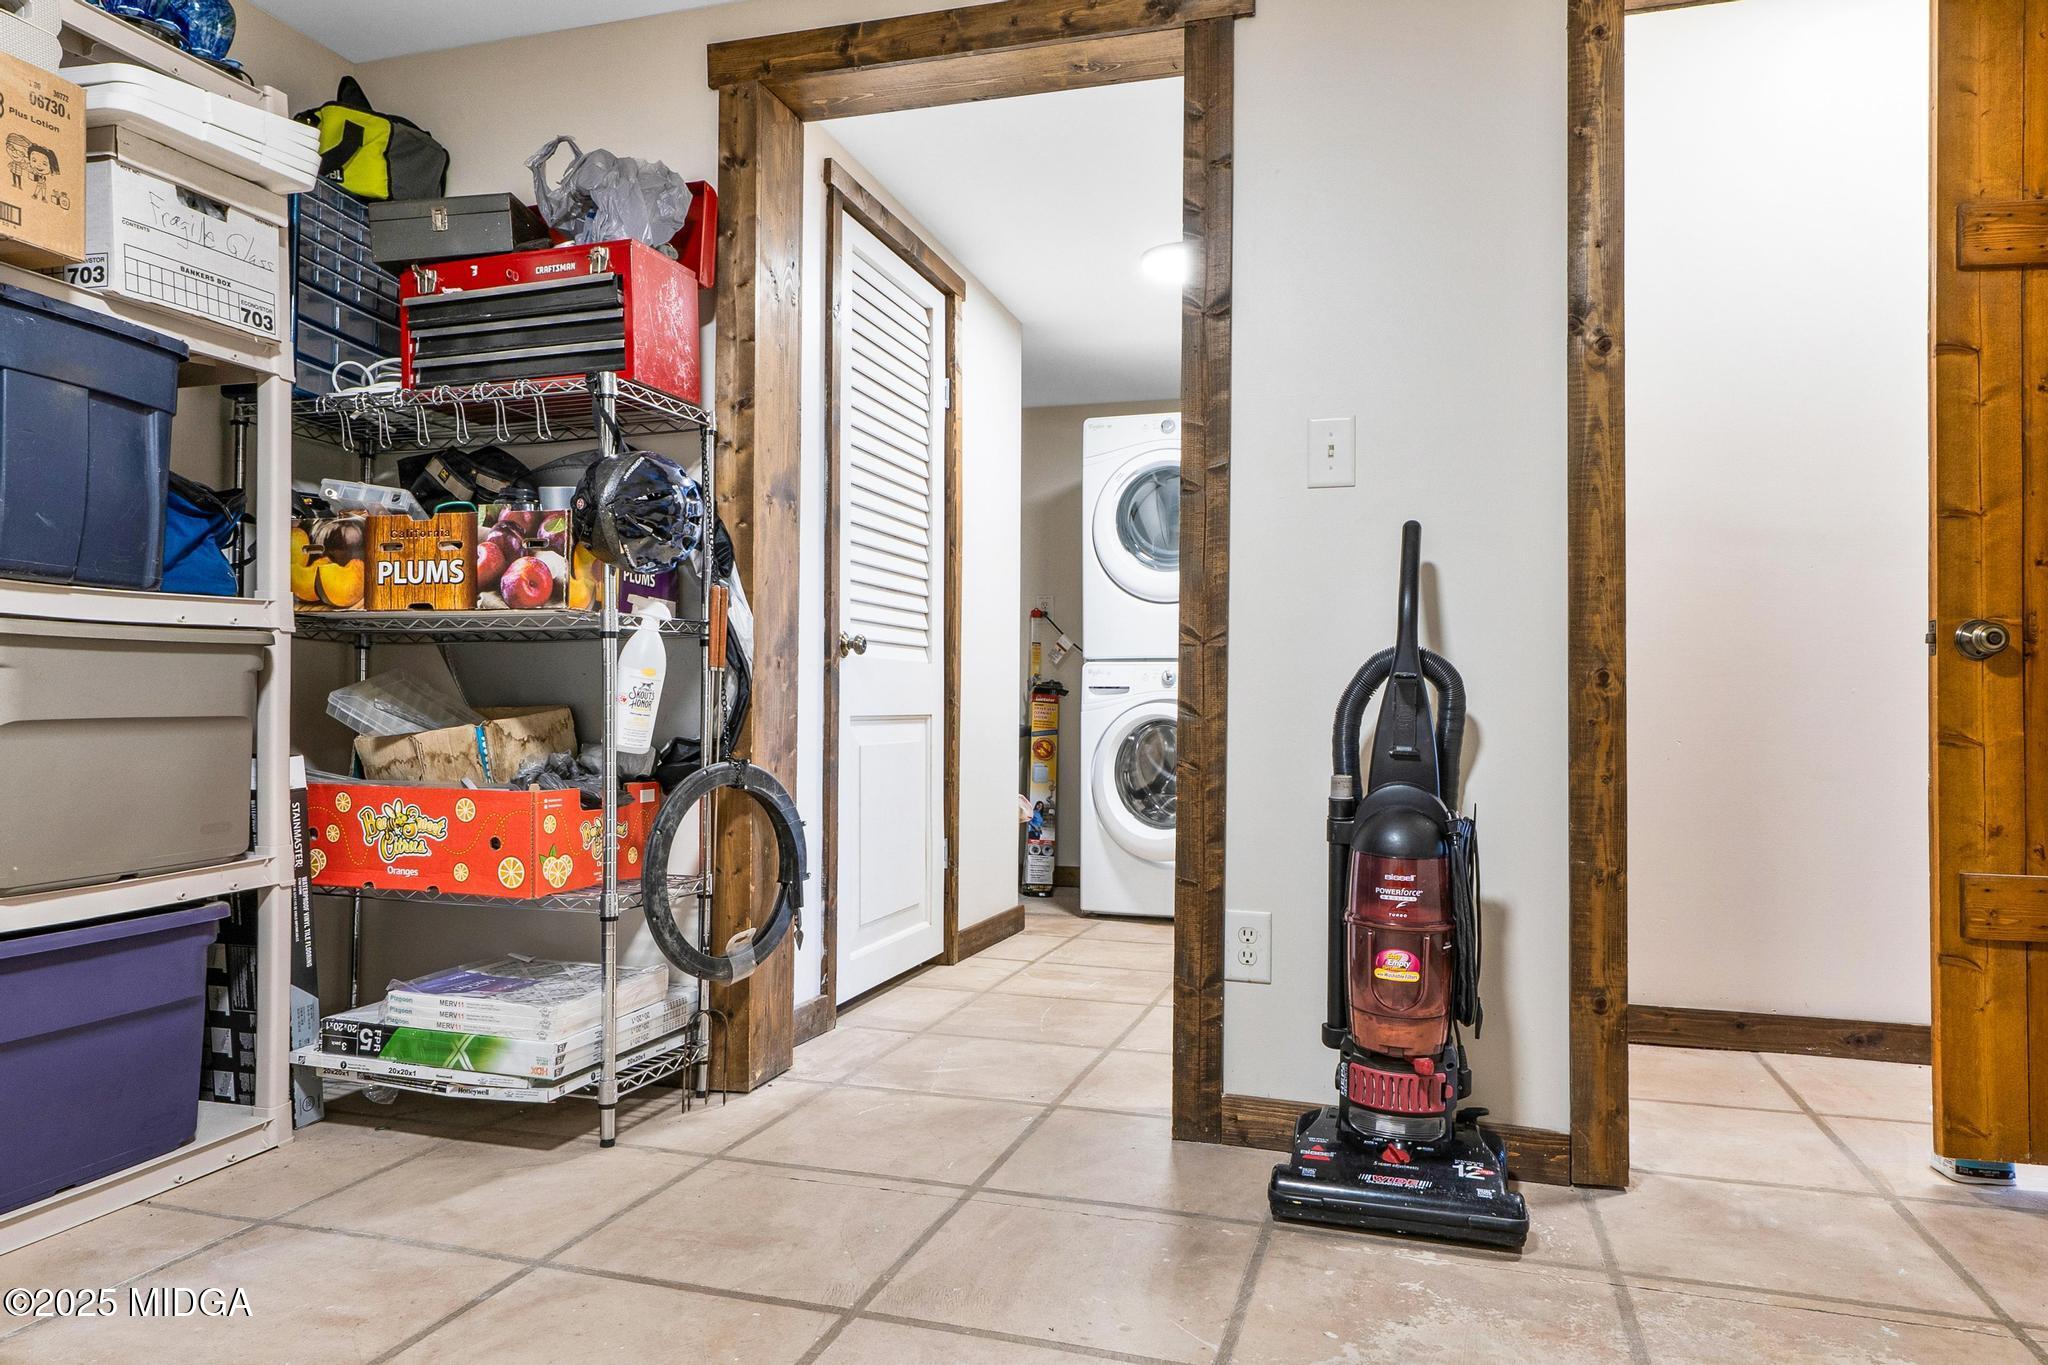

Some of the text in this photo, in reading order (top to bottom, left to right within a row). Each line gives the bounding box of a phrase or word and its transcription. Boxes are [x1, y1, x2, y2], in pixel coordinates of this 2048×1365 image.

[9, 106, 60, 133] Plus Lotion
[121, 219, 151, 232] CONTENTS
[67, 265, 105, 284] 703
[535, 262, 576, 275] CRAFTSMAN
[180, 266, 232, 288] BANKERS BOX
[241, 306, 274, 331] 703
[390, 528, 451, 540] California
[377, 559, 465, 586] PLUMS
[623, 570, 656, 588] PLUMS
[291, 801, 304, 868] STAINMASTER
[387, 865, 419, 877] Oranges
[1387, 958, 1411, 970] Empty
[325, 1021, 358, 1033] 20x20x1
[341, 1041, 348, 1051] 3
[359, 1028, 373, 1051] 5
[373, 1029, 382, 1052] FPR
[388, 1067, 417, 1076] 20x20x1
[458, 1087, 490, 1096] Honeywell
[1452, 1164, 1486, 1180] 12
